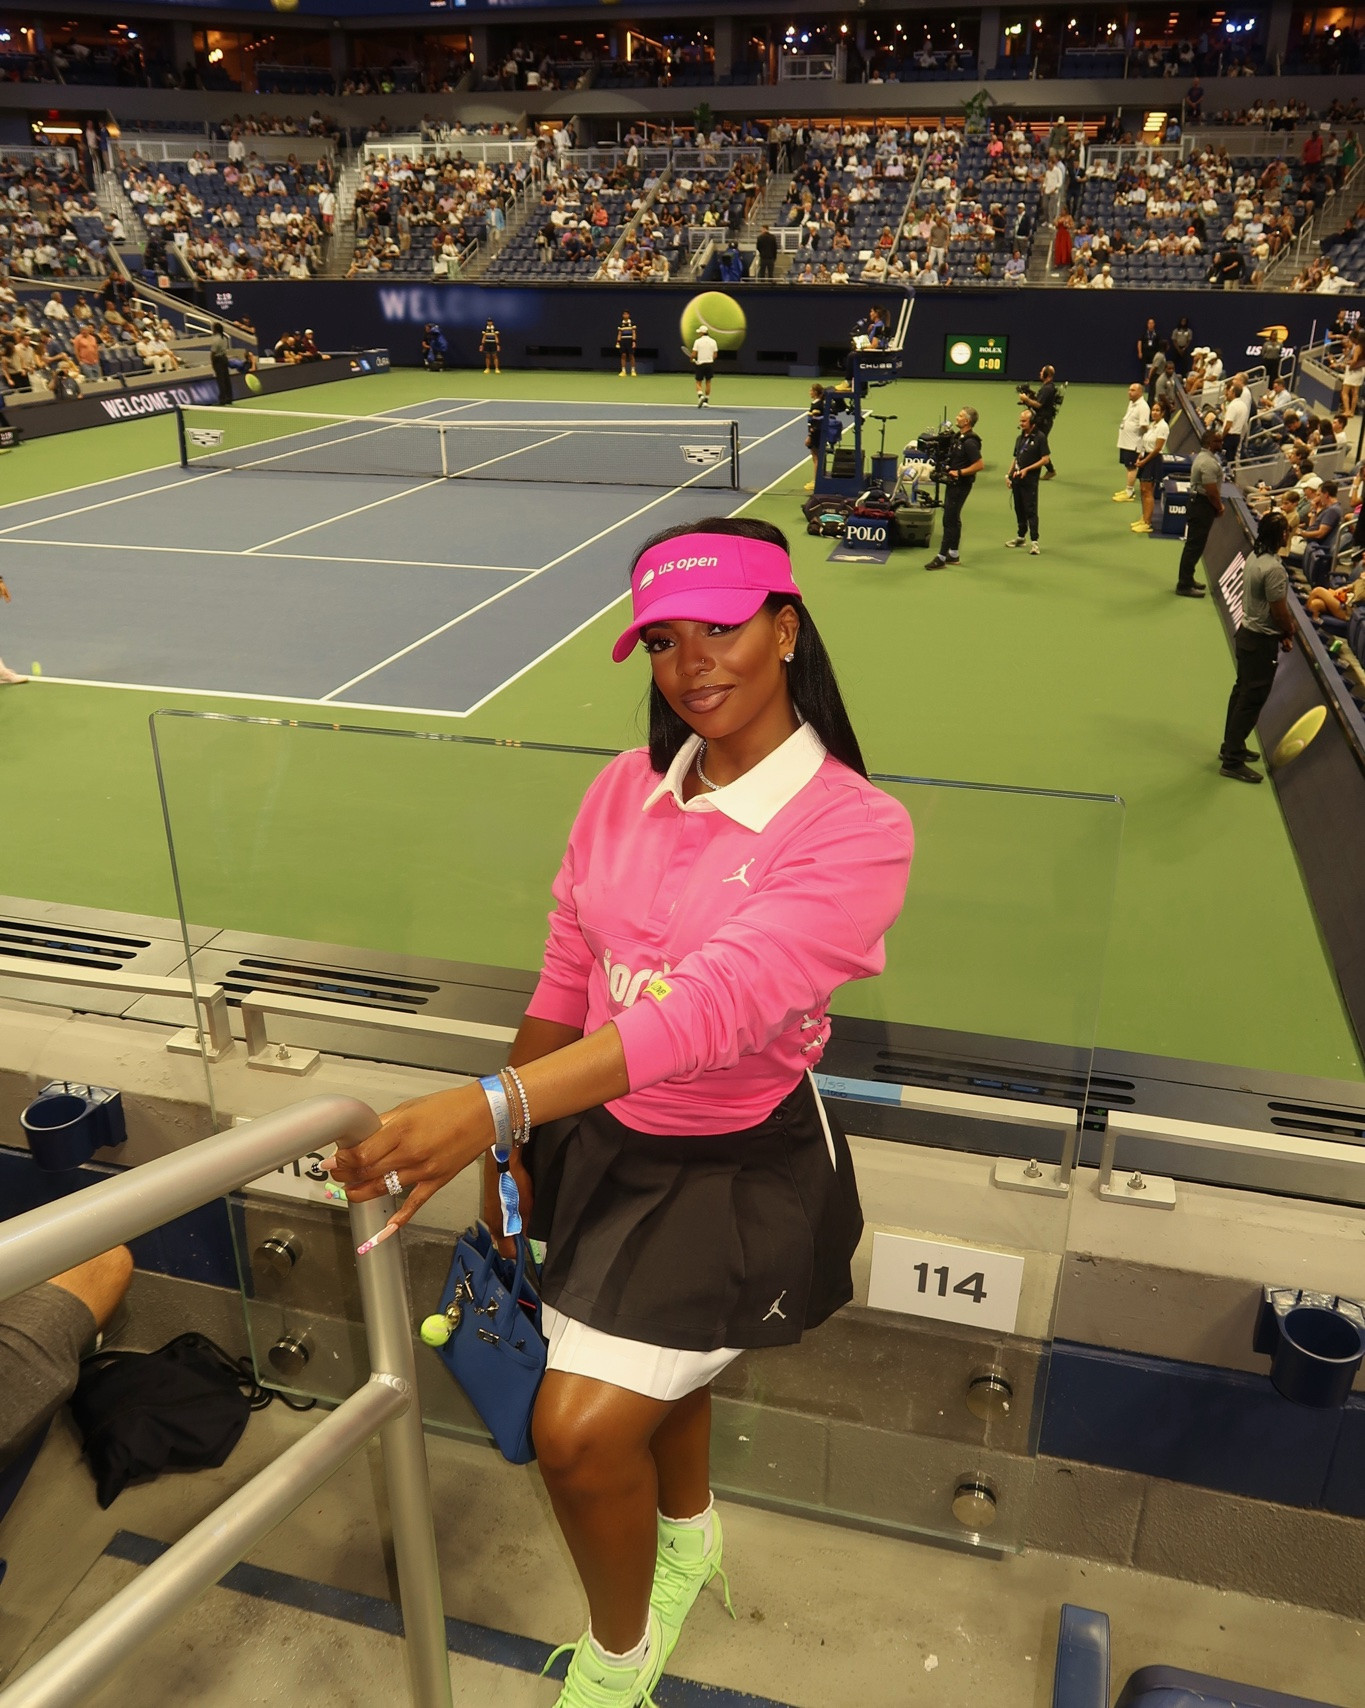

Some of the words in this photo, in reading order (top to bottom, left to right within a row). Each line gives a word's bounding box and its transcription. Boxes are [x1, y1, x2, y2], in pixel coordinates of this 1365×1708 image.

[979, 346, 1003, 354] ROLEX
[979, 358, 1001, 370] 0:00
[101, 391, 174, 419] WELCOME
[168, 388, 191, 406] TO
[846, 525, 887, 543] POLO
[658, 559, 675, 576] us
[675, 556, 718, 571] open
[913, 1262, 988, 1304] 114
